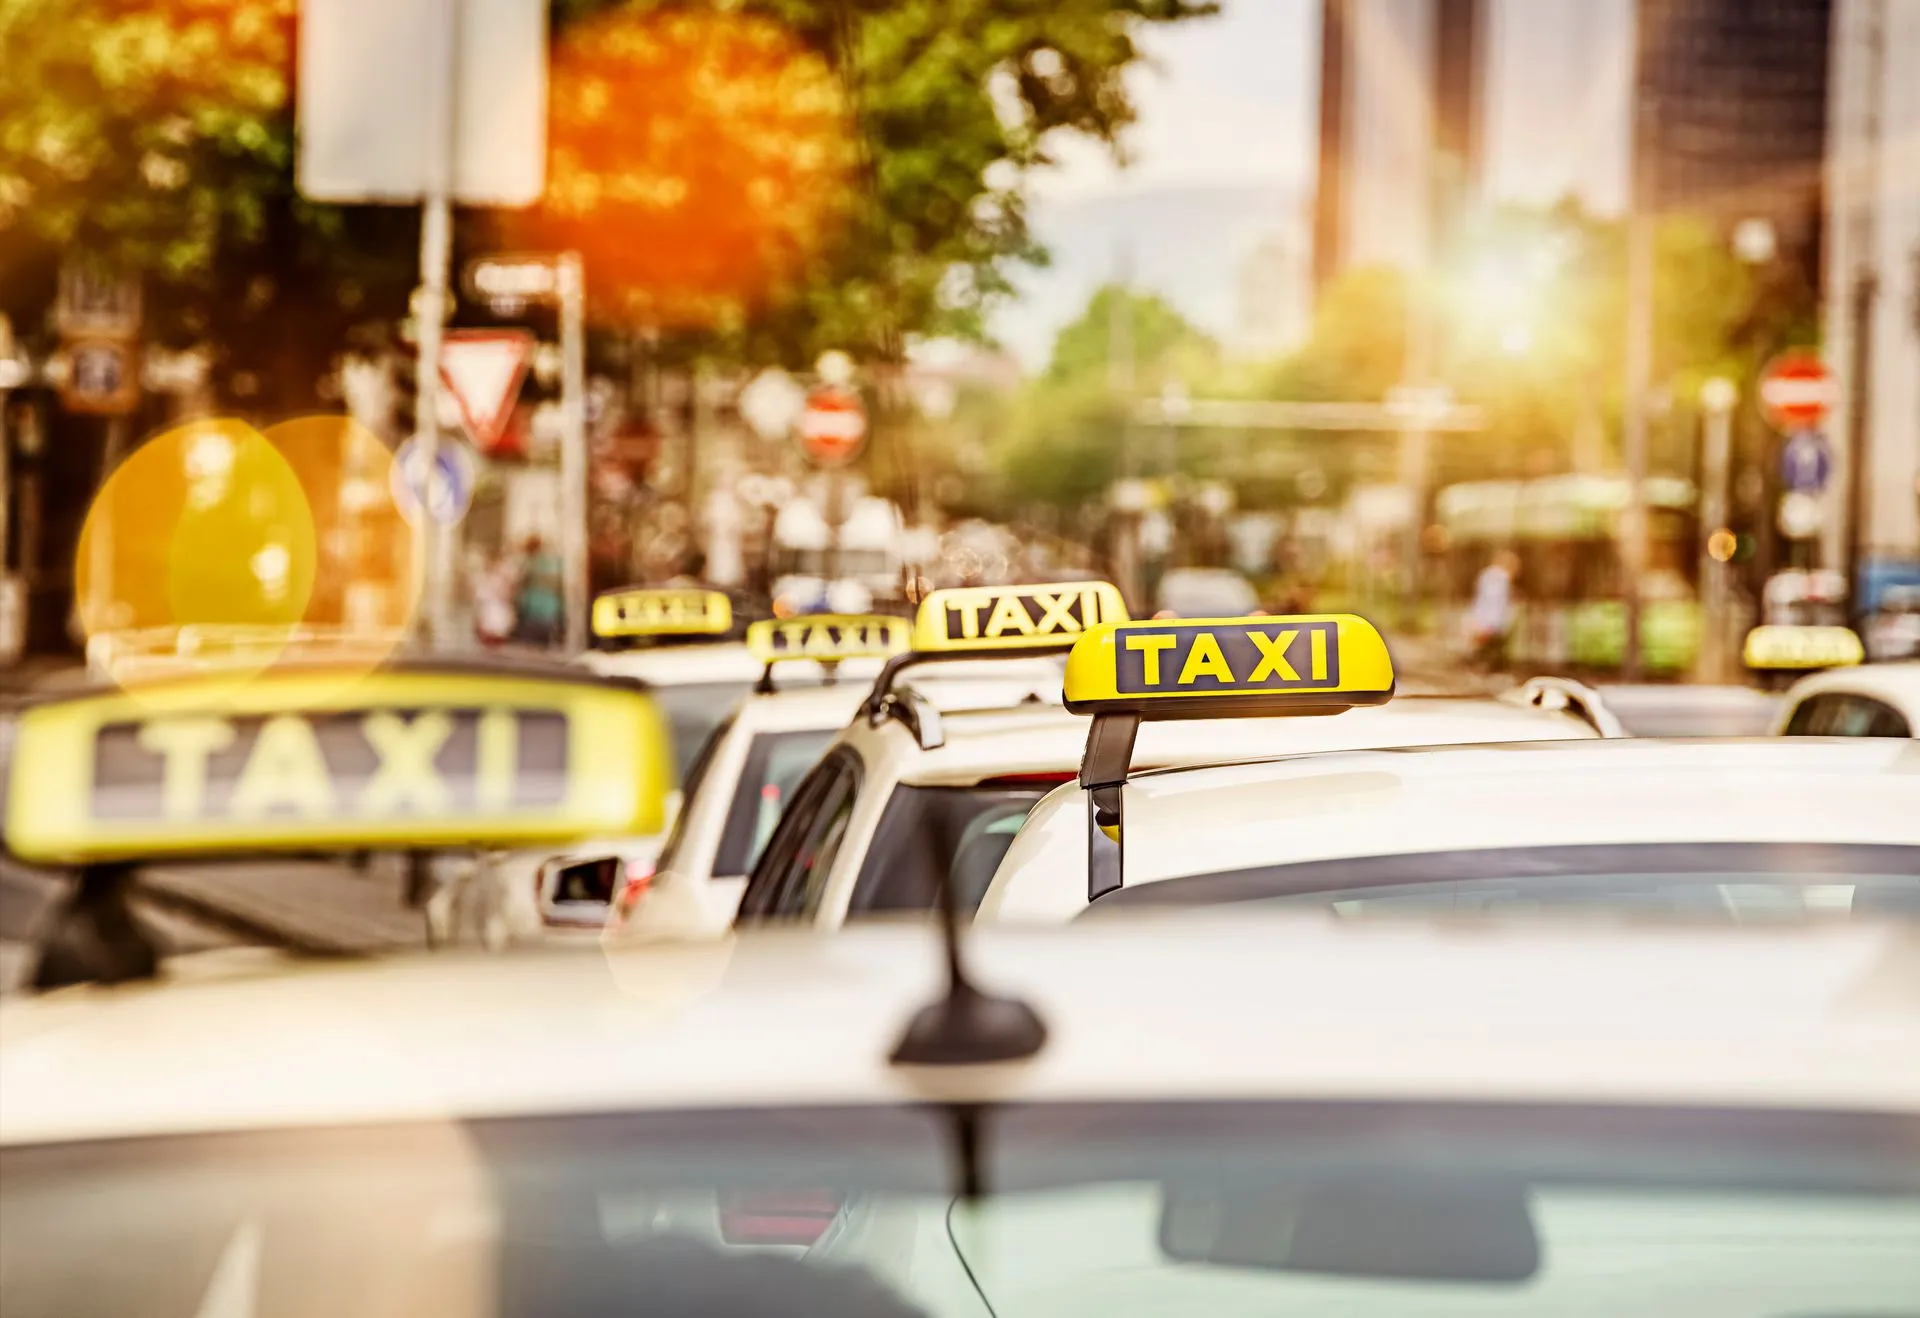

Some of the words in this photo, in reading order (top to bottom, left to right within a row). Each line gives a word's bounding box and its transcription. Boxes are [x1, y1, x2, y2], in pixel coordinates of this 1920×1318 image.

[948, 590, 1097, 639] TAXI
[1124, 629, 1329, 686] TAXI
[136, 709, 519, 820] TAXI
